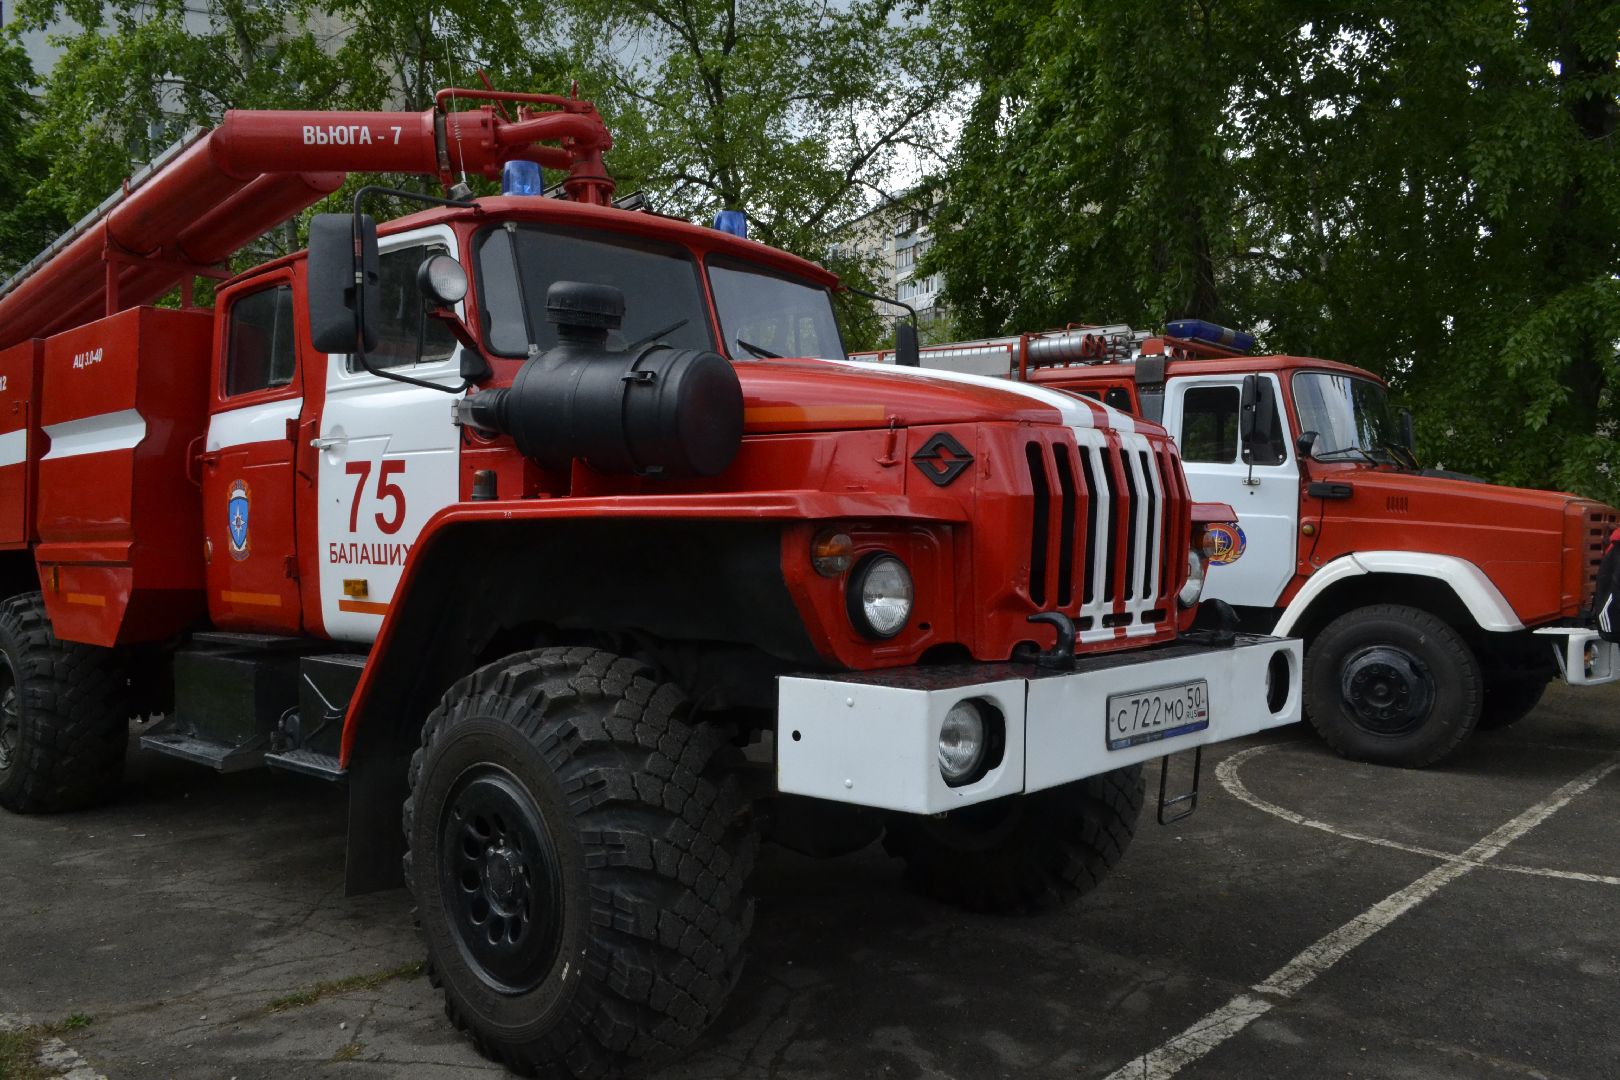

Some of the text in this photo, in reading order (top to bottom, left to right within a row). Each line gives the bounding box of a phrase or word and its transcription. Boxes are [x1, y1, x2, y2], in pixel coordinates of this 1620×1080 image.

[303, 125, 372, 145] ВЬЮГА
[390, 126, 402, 145] 7
[73, 353, 84, 369] АЦ
[345, 459, 406, 535] 75
[1187, 686, 1201, 709] 50
[1186, 709, 1198, 719] RUS
